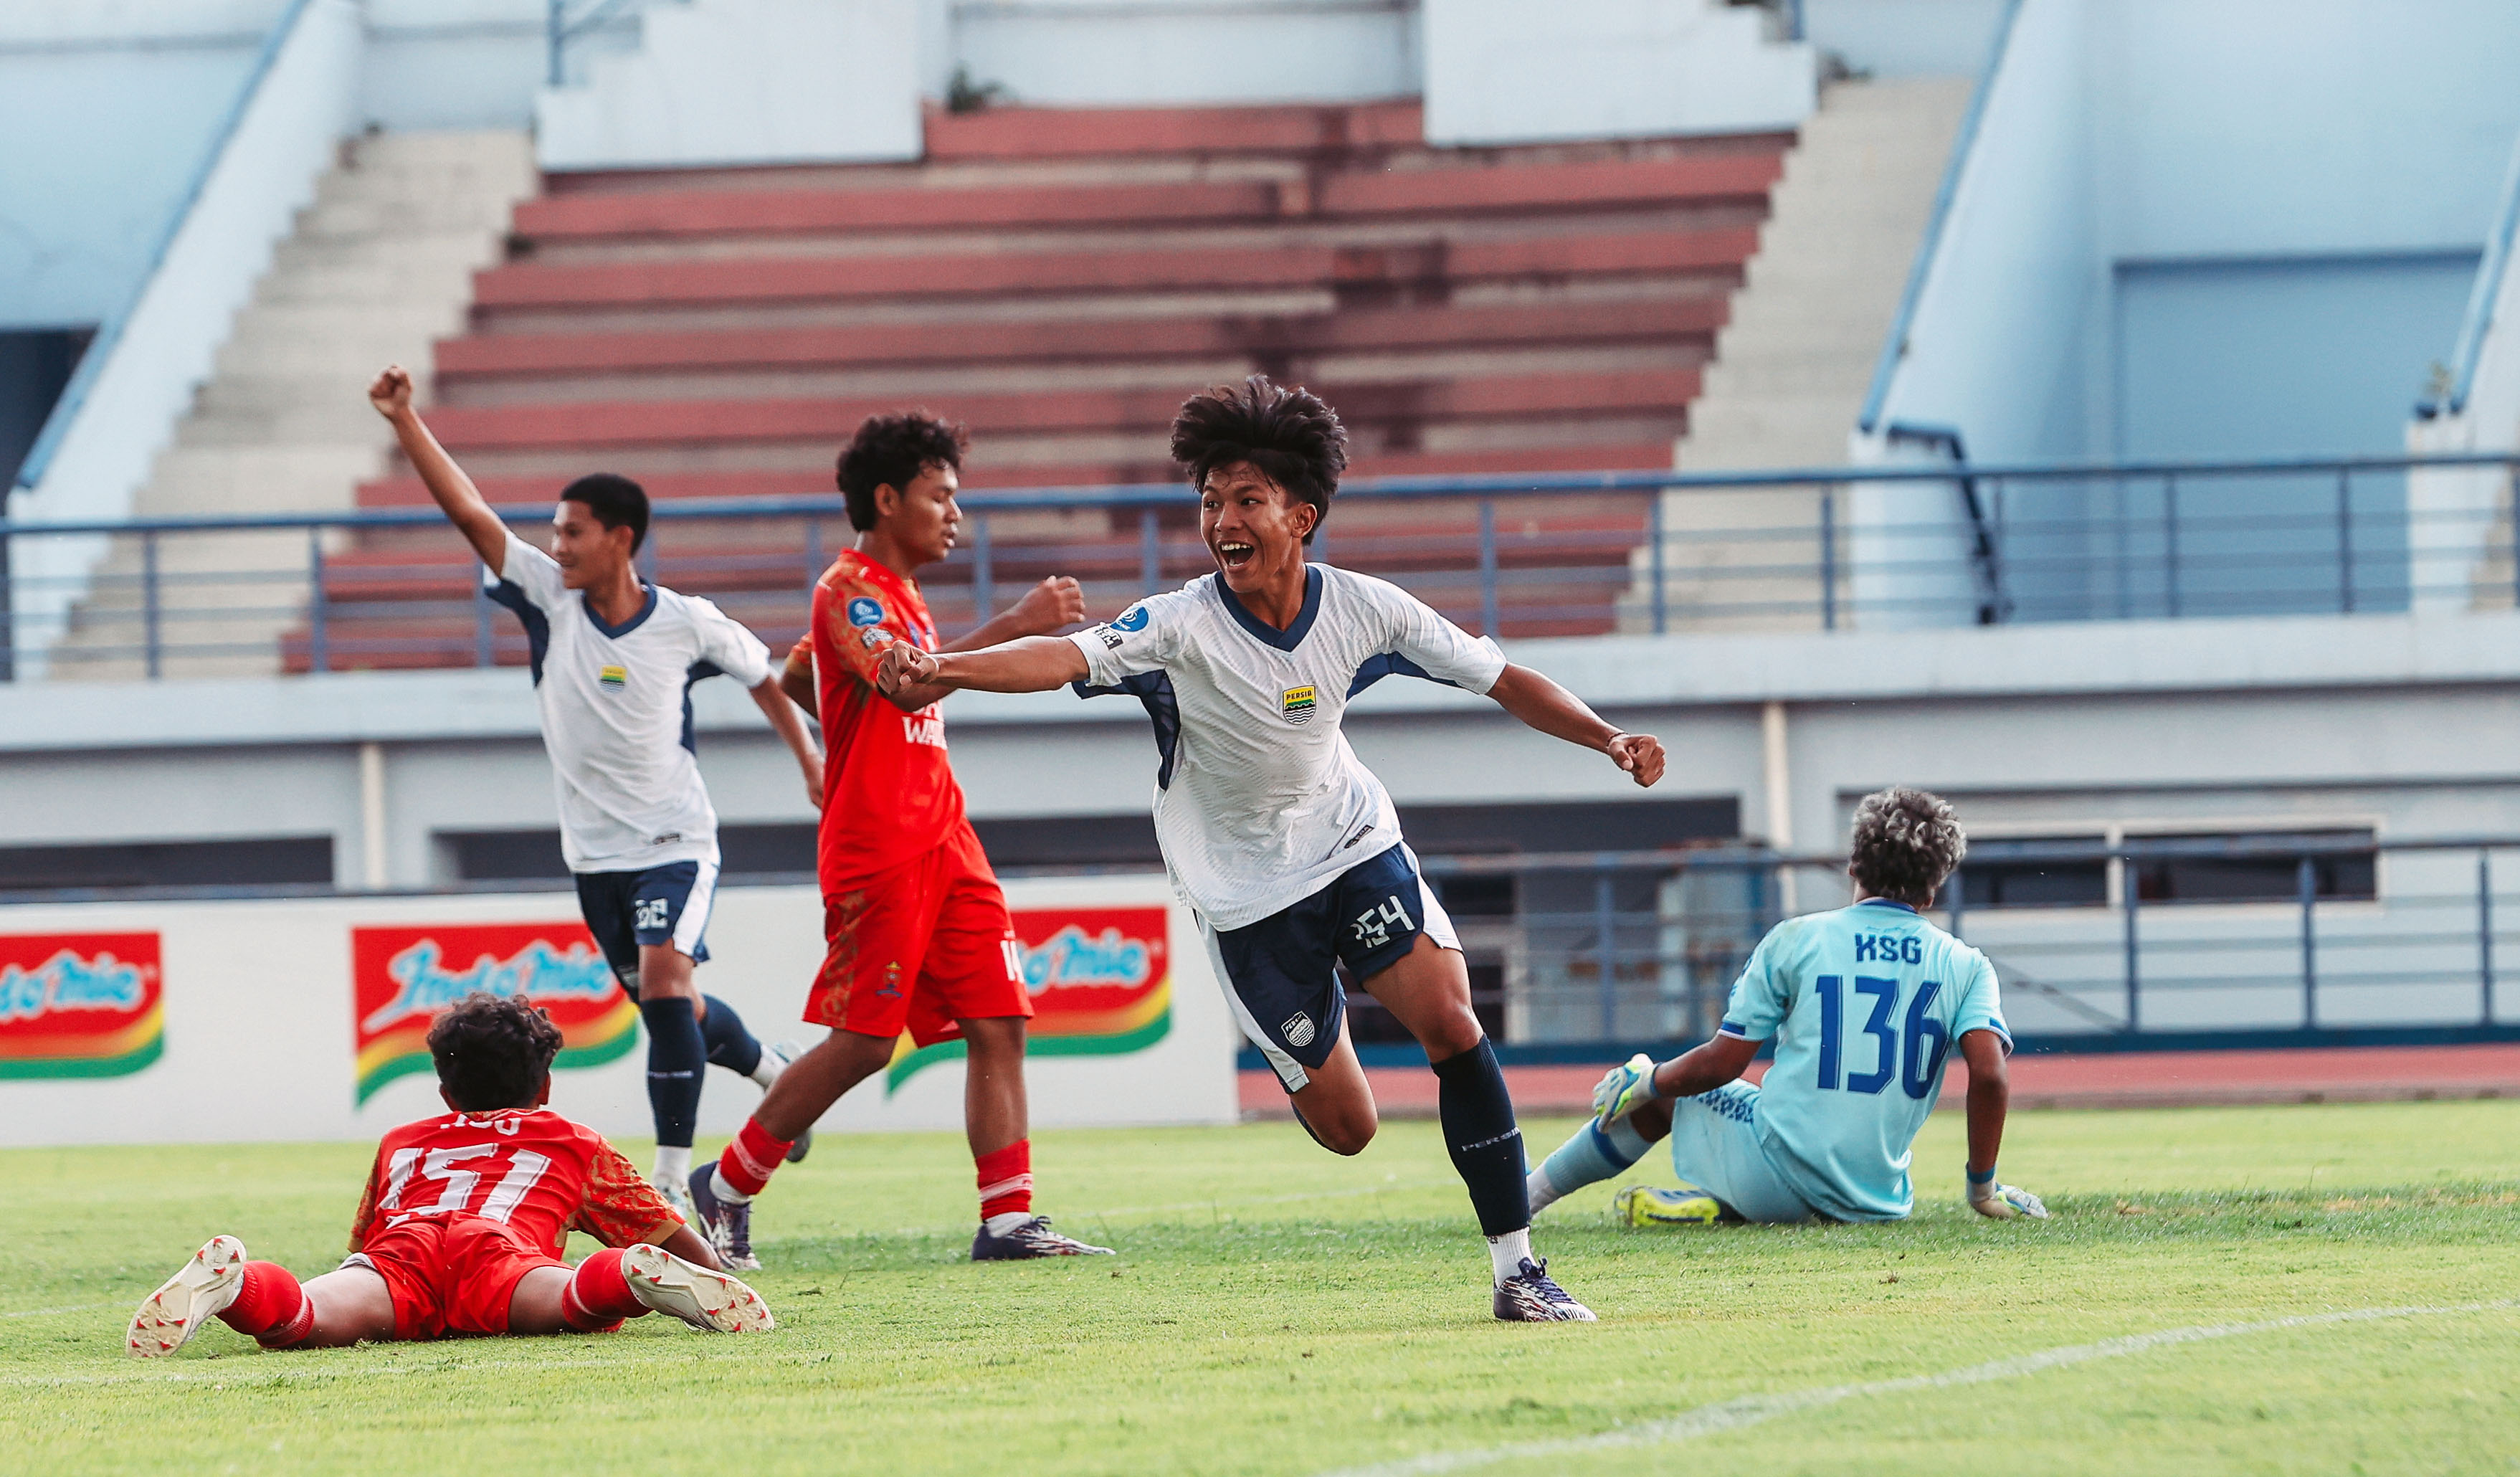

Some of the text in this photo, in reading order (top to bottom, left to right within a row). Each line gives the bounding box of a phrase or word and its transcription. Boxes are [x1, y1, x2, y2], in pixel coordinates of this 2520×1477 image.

[1855, 932, 1922, 965] KSG
[1815, 974, 1950, 1100] 136
[379, 1143, 552, 1229] 151
